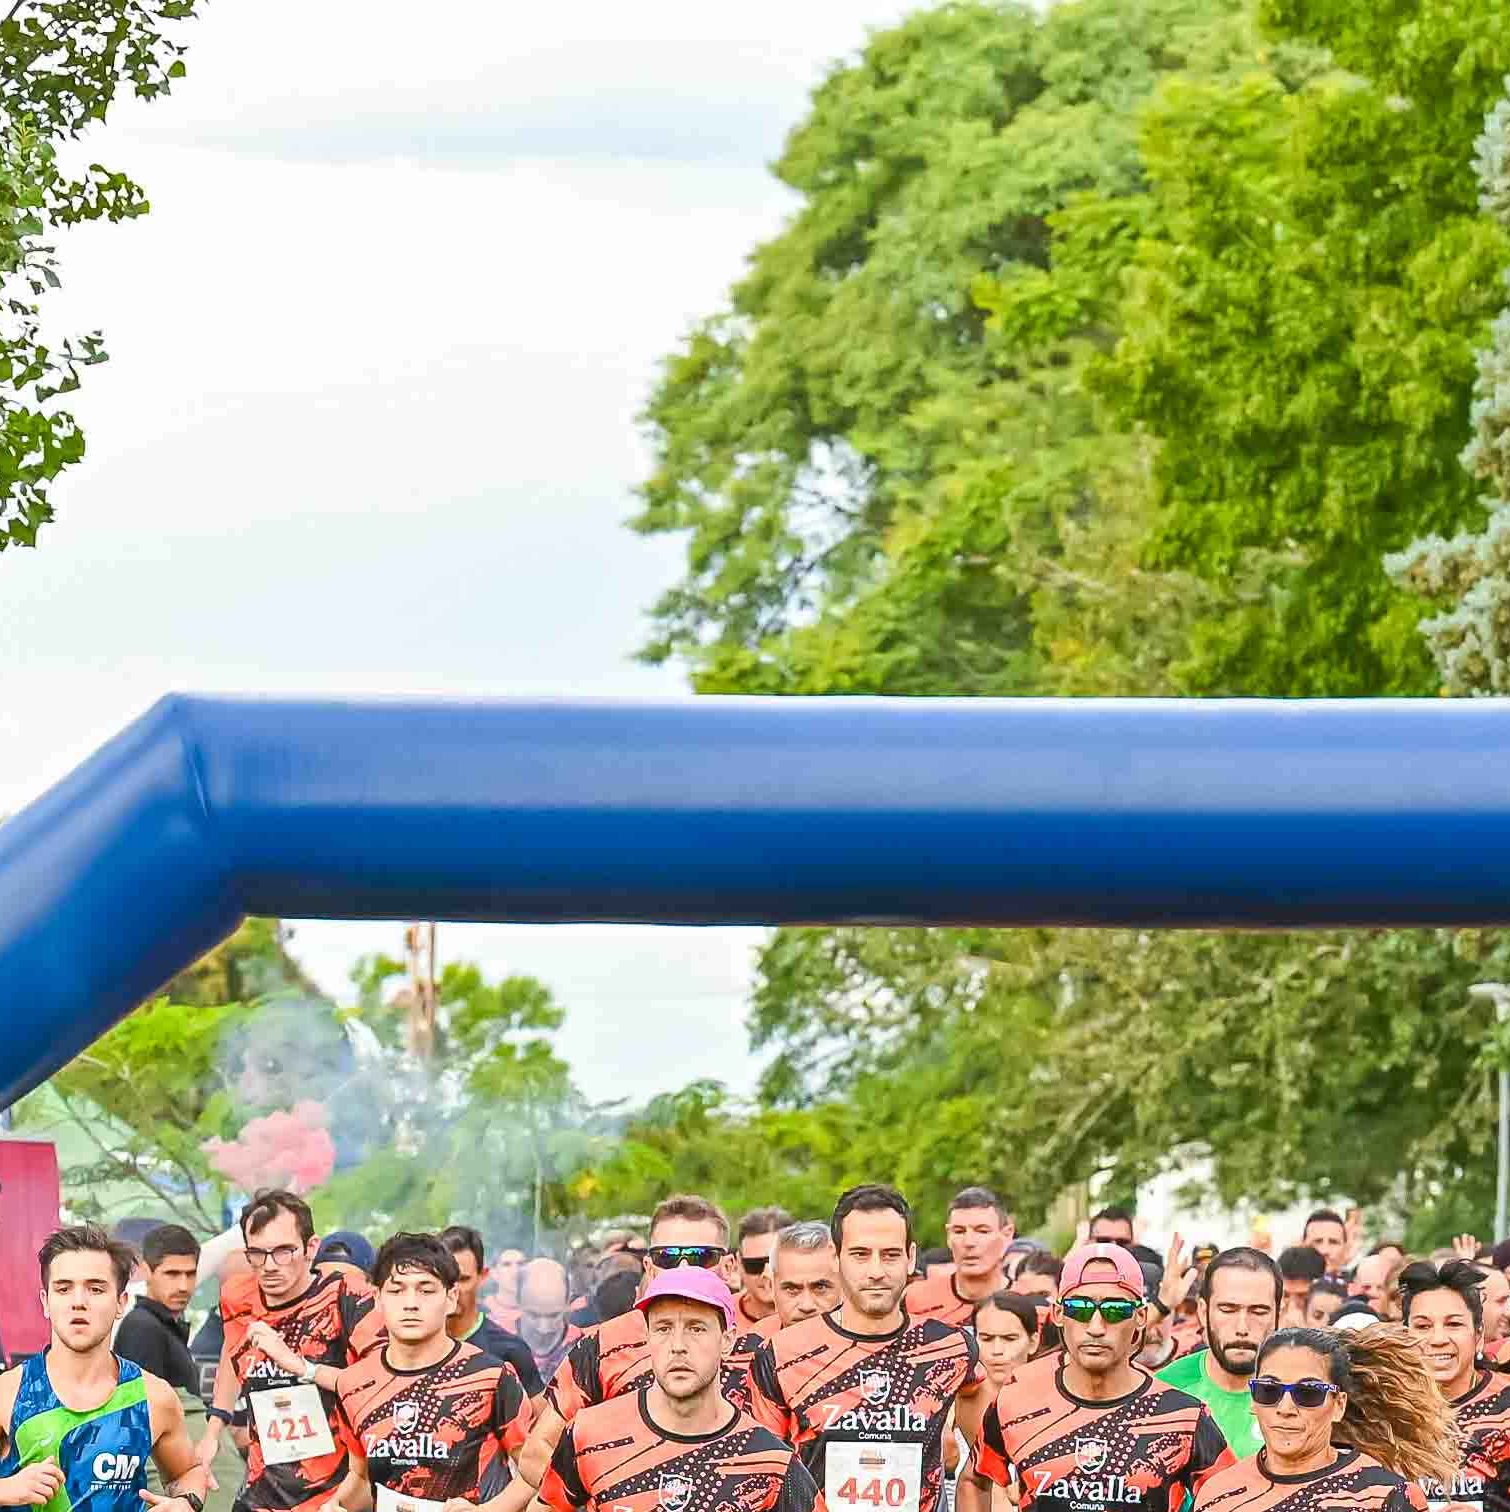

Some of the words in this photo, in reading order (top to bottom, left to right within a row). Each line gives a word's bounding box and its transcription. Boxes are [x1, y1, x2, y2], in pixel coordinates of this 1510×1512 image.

[267, 1415, 317, 1443] 421
[823, 1404, 926, 1432] Zavalla
[363, 1432, 450, 1460] Zavalla
[858, 1431, 892, 1440] Comuna
[92, 1451, 141, 1482] CM
[837, 1477, 906, 1507] 440
[1032, 1470, 1142, 1504] Zavalla
[1069, 1500, 1105, 1511] Comuna
